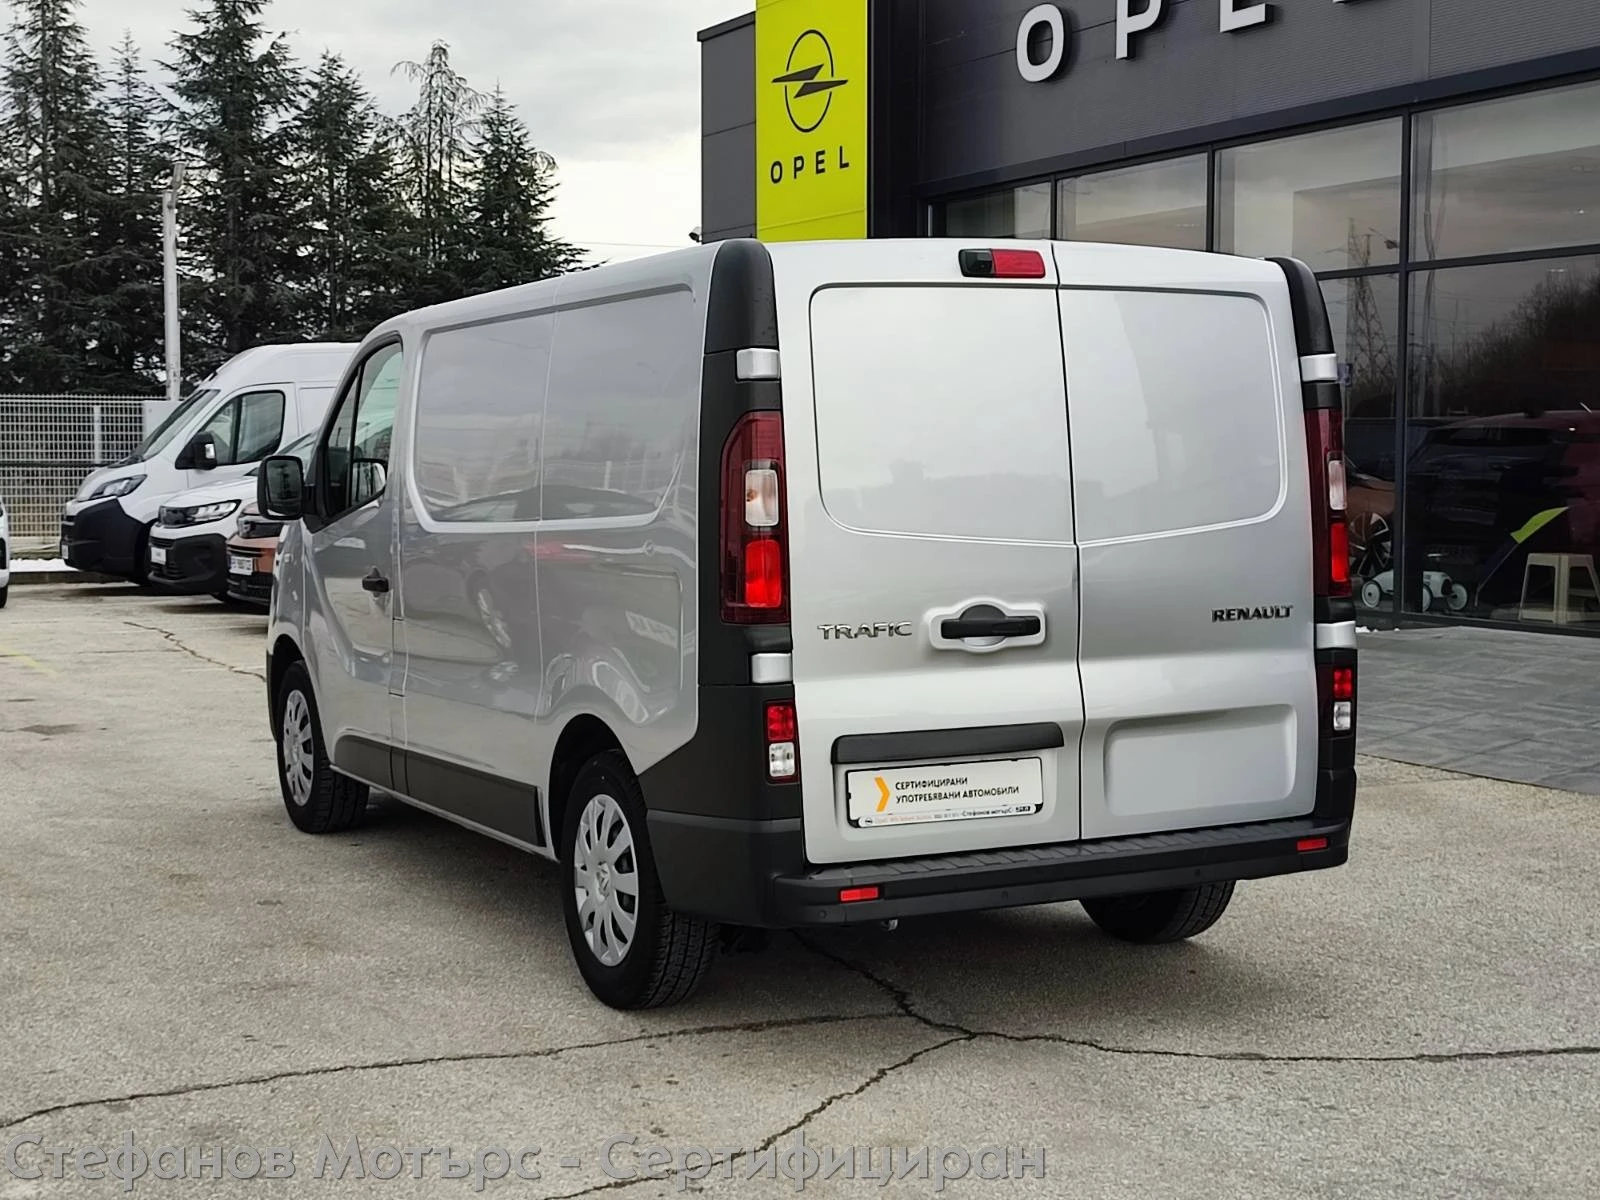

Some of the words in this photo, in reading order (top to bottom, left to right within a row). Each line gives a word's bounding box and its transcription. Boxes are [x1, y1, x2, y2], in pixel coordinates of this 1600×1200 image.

[1016, 0, 1345, 82] OP
[770, 145, 849, 184] OPEL
[1211, 605, 1293, 623] RENAULT
[818, 621, 912, 640] TRAFIC
[895, 777, 968, 790] СЕРТИФИЦИРАНИ
[896, 791, 961, 804] УПОТРЕБЯВАНИ
[962, 786, 1020, 799] АВТОМОБИЛИ
